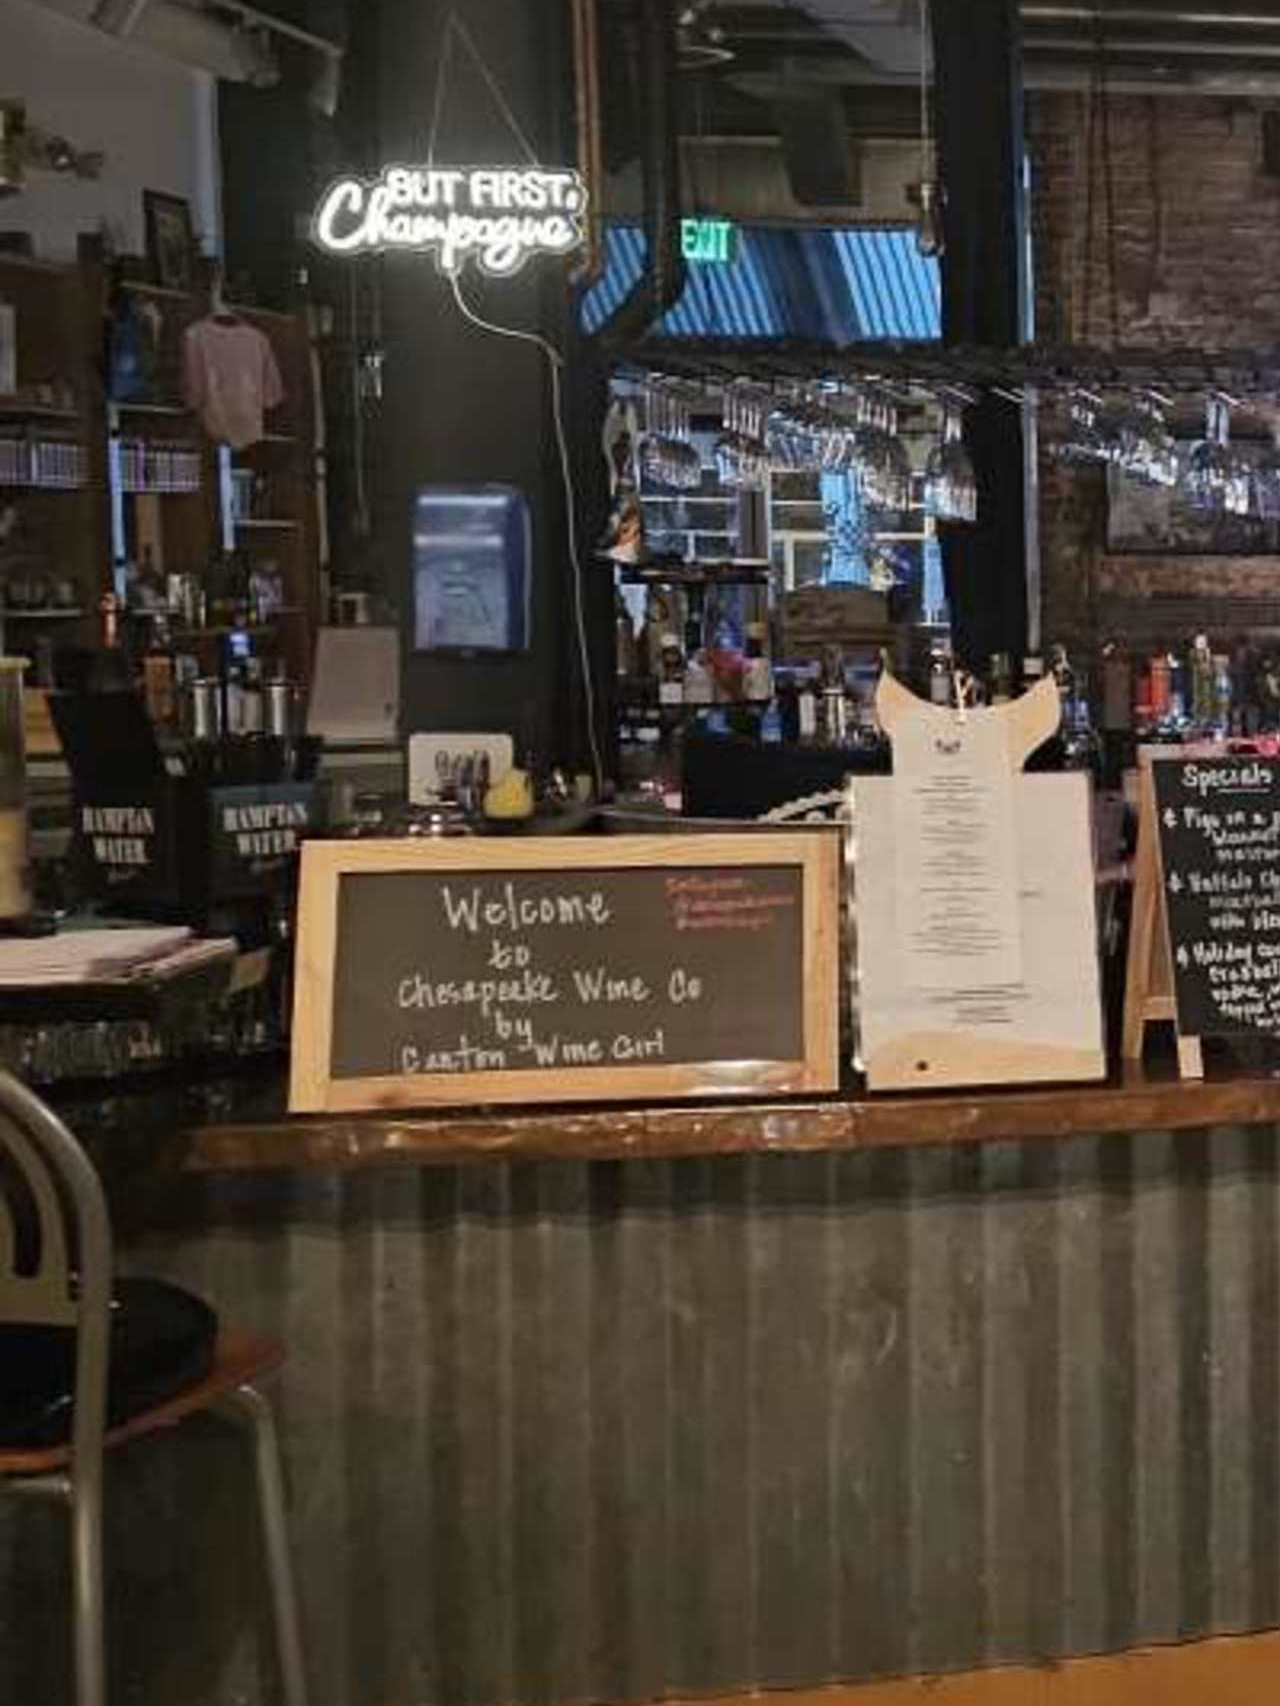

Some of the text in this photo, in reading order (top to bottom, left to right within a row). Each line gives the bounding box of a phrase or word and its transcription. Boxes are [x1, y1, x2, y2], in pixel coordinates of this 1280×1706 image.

[387, 170, 463, 206] BUT
[318, 180, 572, 270] Champagne
[680, 218, 732, 262] EXIT
[1181, 763, 1273, 796] Specials
[82, 806, 155, 834] HAMPTON
[223, 803, 308, 832] HAMPTON
[93, 837, 147, 864] WATER
[237, 829, 297, 855] WATER
[441, 881, 612, 933] Welcome
[487, 940, 531, 971] to
[397, 967, 704, 1018] Chesapeake Wine Co
[494, 1009, 535, 1054] by
[400, 1027, 666, 1074] Canton Wine Girl
